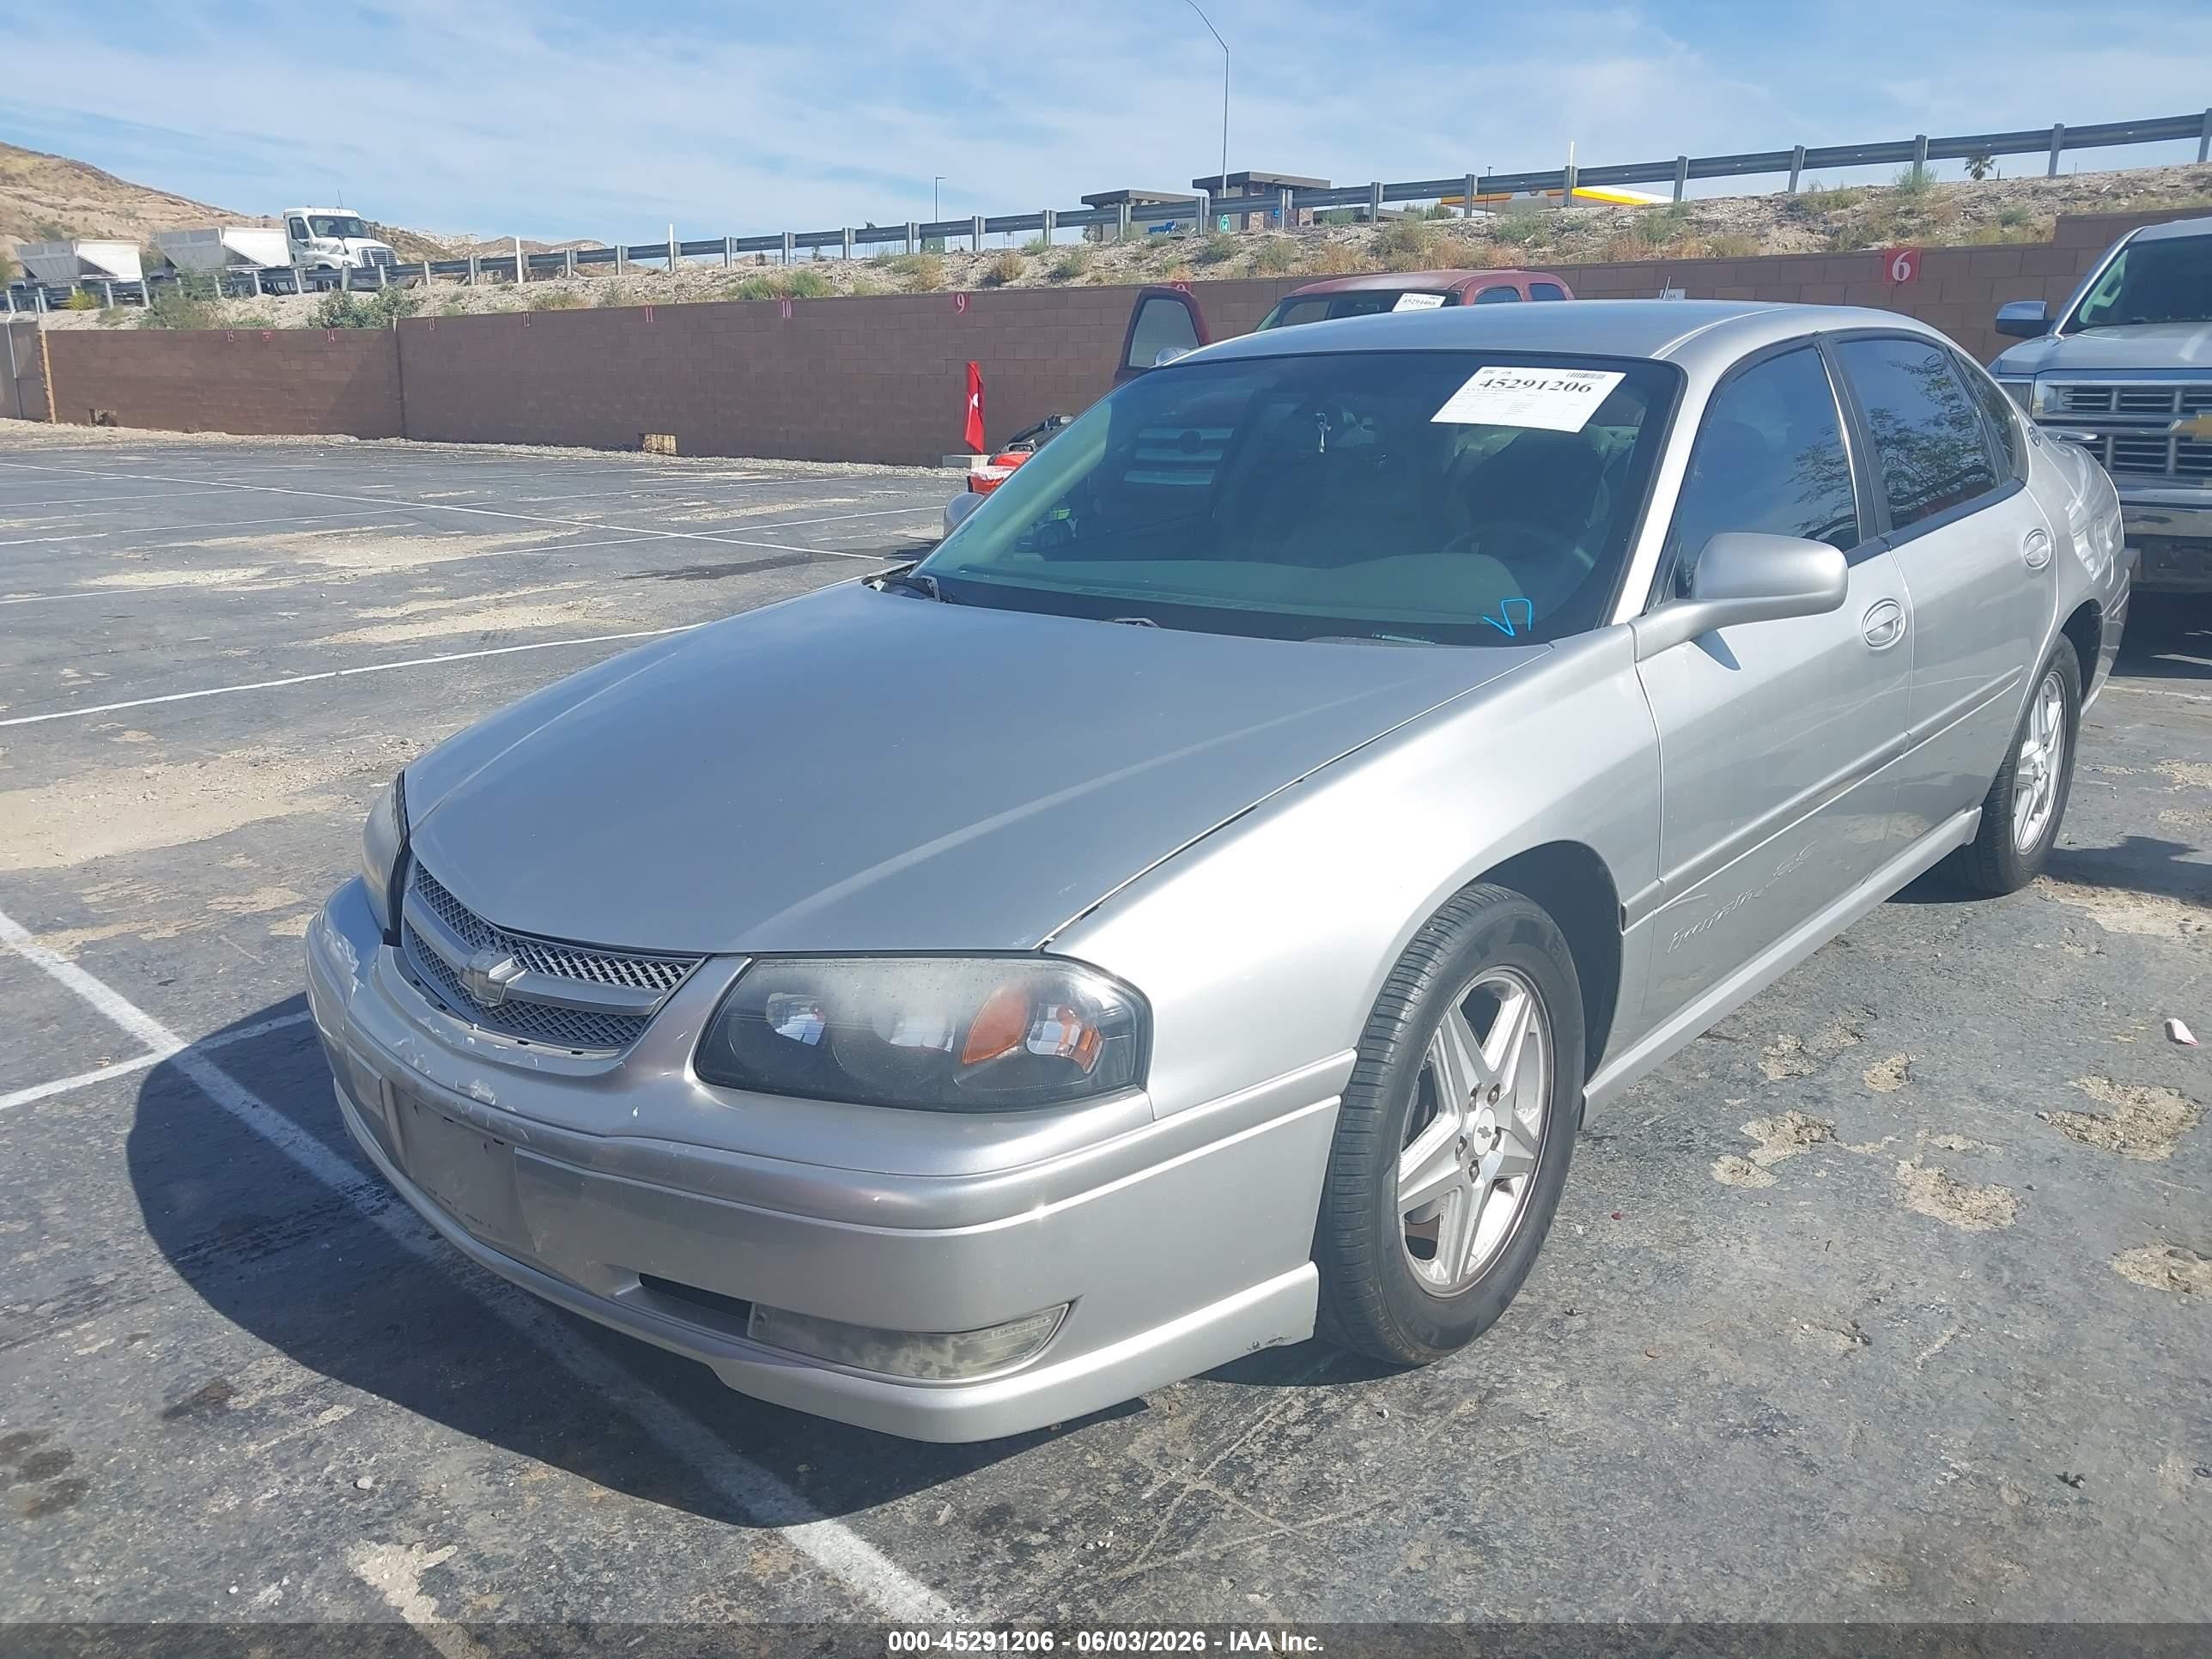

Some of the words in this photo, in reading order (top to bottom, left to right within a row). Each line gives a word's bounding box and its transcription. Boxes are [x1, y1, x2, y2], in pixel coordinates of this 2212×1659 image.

[1892, 250, 1913, 282] 6
[782, 301, 792, 318] 10
[957, 294, 965, 313] 9
[645, 306, 653, 323] 11
[1479, 378, 1593, 394] 45291206
